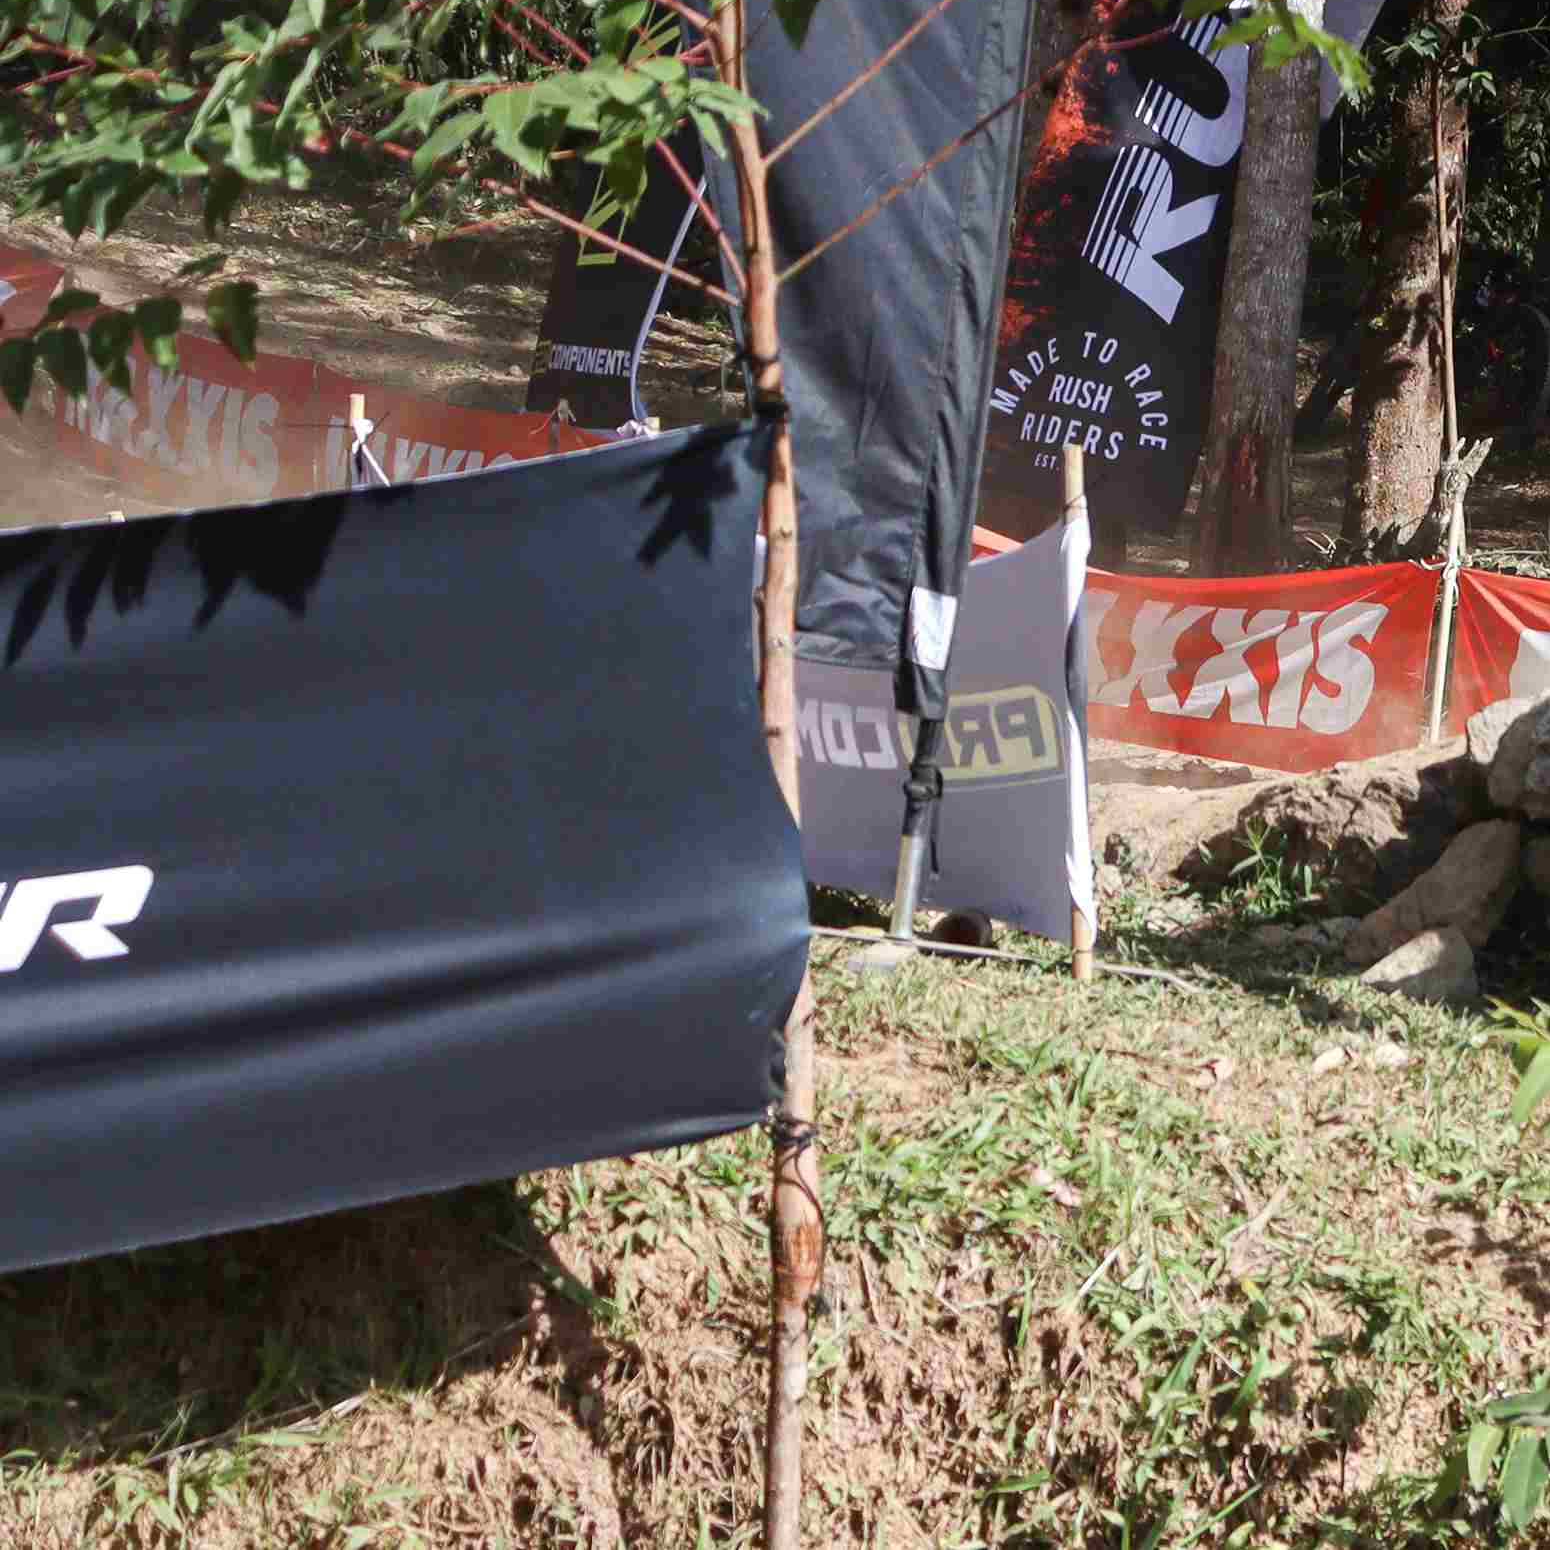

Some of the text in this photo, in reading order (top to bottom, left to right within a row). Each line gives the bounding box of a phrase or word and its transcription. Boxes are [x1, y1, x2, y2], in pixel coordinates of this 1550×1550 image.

[548, 343, 633, 378] COMPONENTS
[989, 330, 1169, 451] MADE TO RACE
[1048, 374, 1113, 414] RUSH
[1019, 412, 1124, 460] RIDERS
